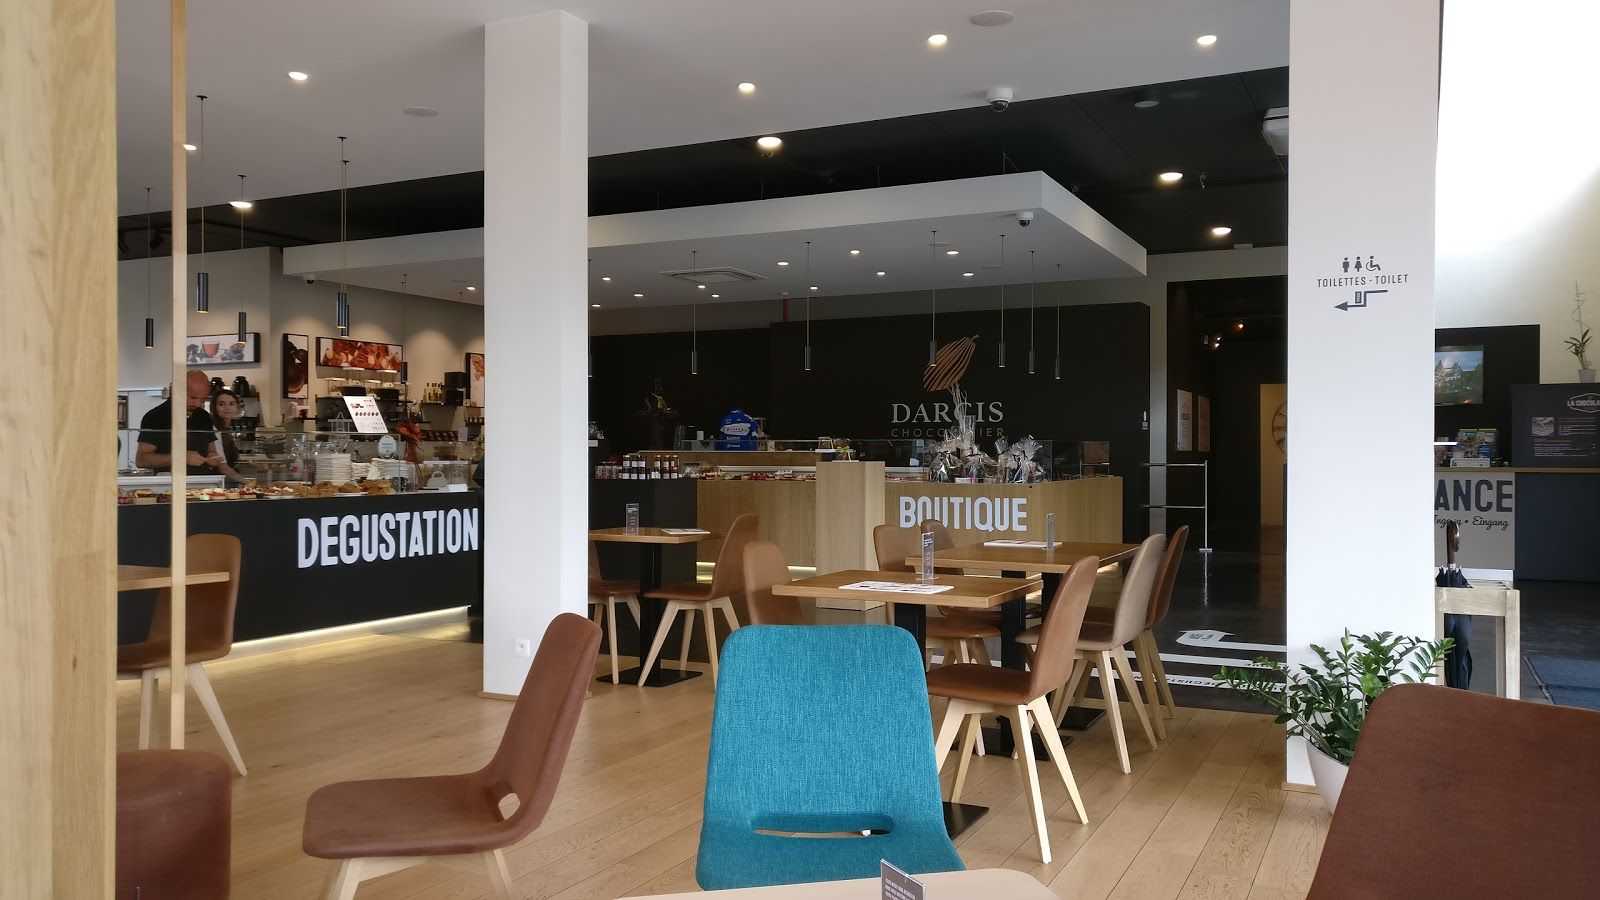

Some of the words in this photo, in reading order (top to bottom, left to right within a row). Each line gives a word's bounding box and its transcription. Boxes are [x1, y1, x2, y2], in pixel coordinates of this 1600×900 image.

[1317, 276, 1366, 288] TOILETTES
[1375, 274, 1409, 285] TOILET
[890, 401, 1004, 424] DARCIS
[891, 428, 1004, 438] CHOCOIER
[1434, 479, 1513, 512] ANCE
[899, 496, 1028, 532] BOUTIQUE
[1472, 516, 1510, 531] Eingang
[297, 507, 479, 569] DEGUSTATION
